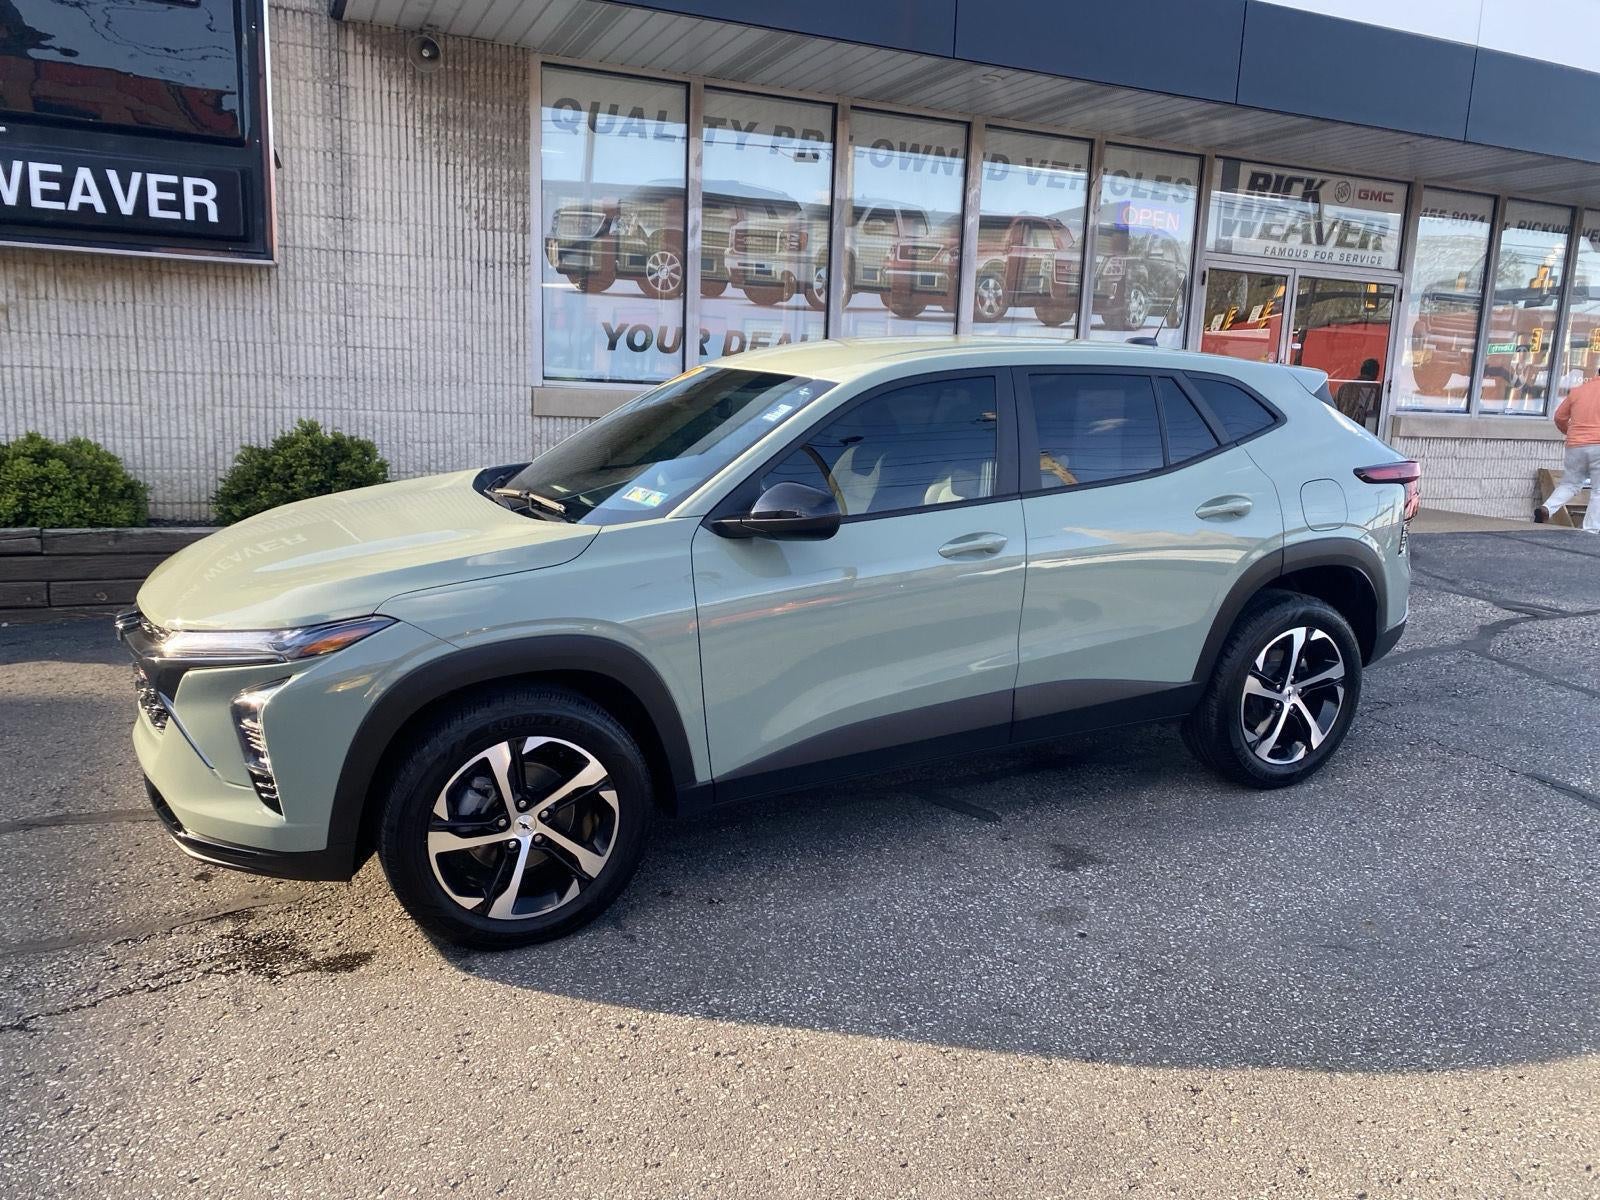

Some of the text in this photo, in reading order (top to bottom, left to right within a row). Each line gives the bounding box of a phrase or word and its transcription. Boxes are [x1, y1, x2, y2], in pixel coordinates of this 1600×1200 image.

[550, 97, 1192, 204] QUALTY PR-OWND VEHCLES
[1246, 171, 1331, 204] RICK
[1357, 188, 1395, 204] GMC
[1122, 206, 1181, 231] OPEN
[1217, 198, 1390, 251] WEAVER
[1263, 246, 1383, 265] FAMOUS FOR SERVICE
[602, 322, 711, 355] YOUR
